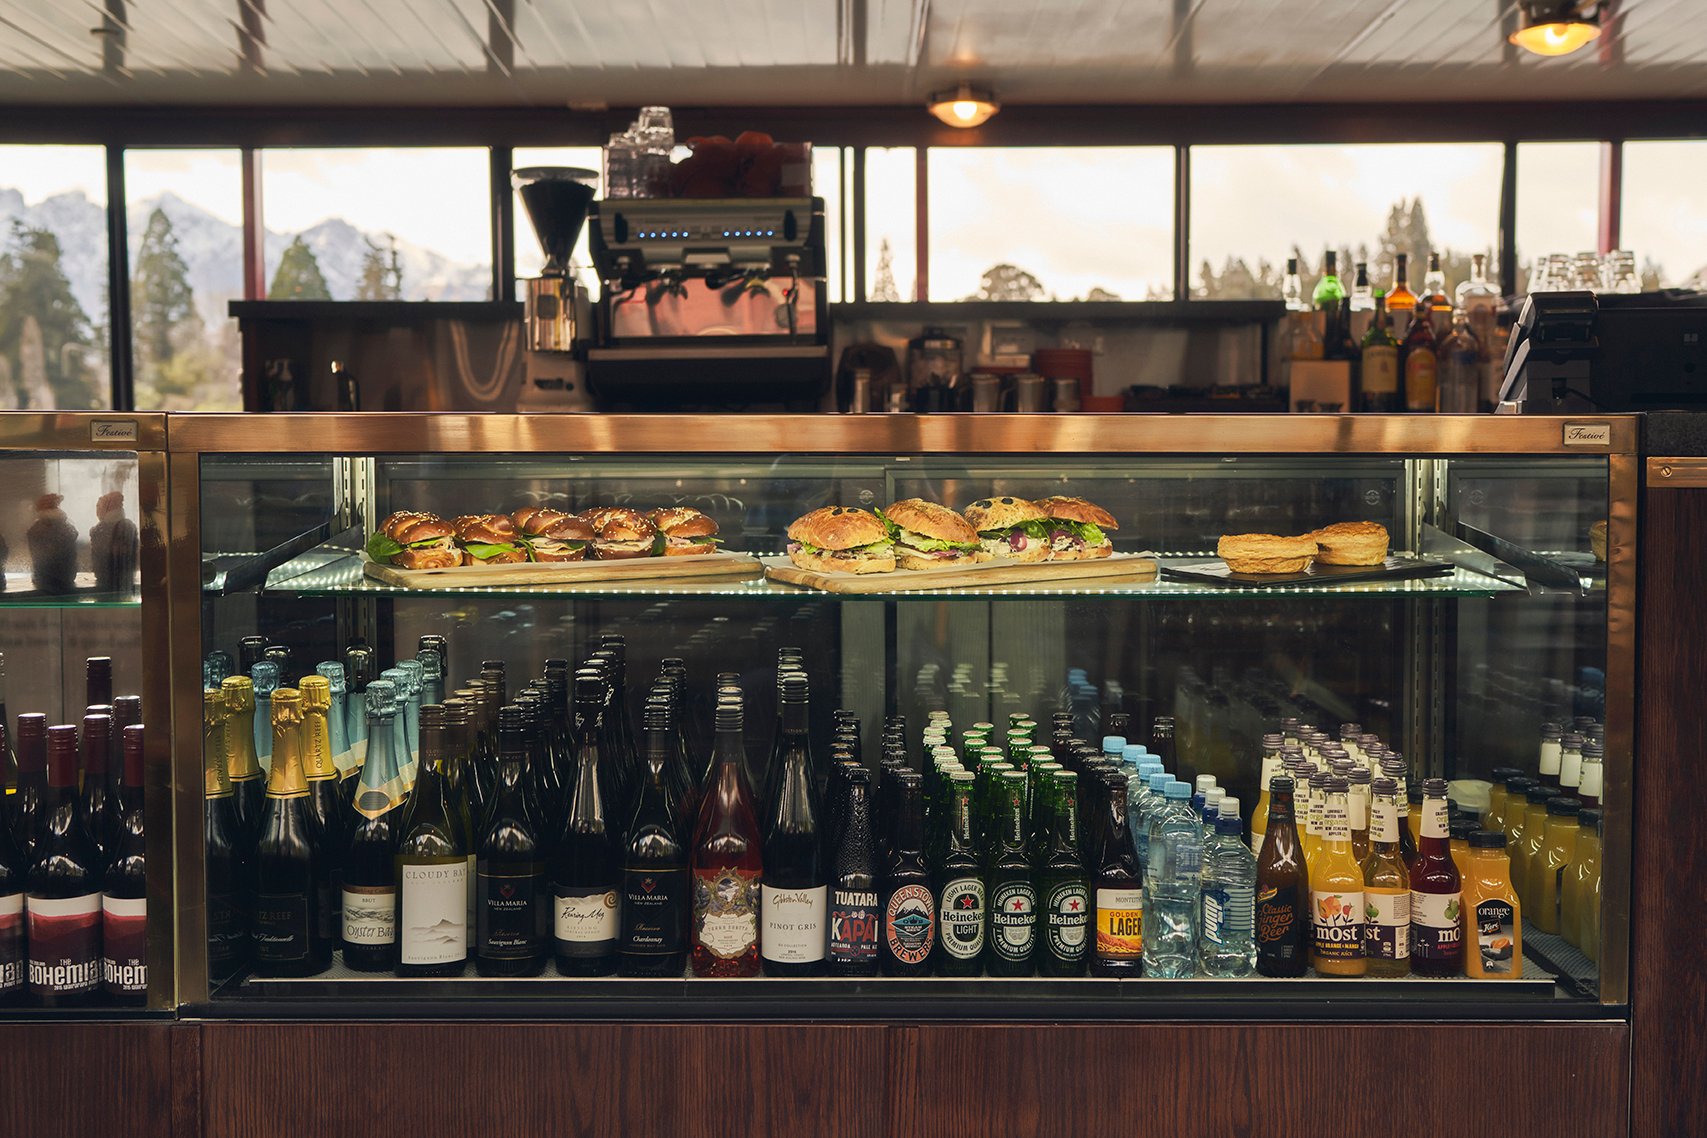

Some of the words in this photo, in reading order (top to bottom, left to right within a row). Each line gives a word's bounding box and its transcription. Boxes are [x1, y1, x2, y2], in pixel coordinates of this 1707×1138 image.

[1568, 427, 1605, 440] Festivé
[315, 739, 323, 769] QUARTZ
[1013, 807, 1021, 841] Heineken
[1068, 807, 1076, 841] Heineken
[405, 870, 449, 880] CLOUDY
[794, 892, 814, 909] Valley
[835, 891, 878, 907] TUATARA
[946, 887, 960, 903] LIGHT
[1262, 903, 1292, 914] Classic
[1478, 907, 1510, 919] orange
[769, 922, 793, 930] PINOT
[1204, 895, 1223, 944] pump
[346, 924, 376, 940] Oyster
[831, 917, 879, 942] KAPAI
[956, 924, 979, 935] LIGHT
[1259, 924, 1289, 943] Beer
[1316, 926, 1358, 942] most
[1366, 926, 1381, 941] st
[1437, 927, 1460, 942] mo
[632, 936, 663, 944] Chardonnay
[945, 932, 969, 951] PREMIUM
[996, 934, 1019, 953] PREMIUM
[890, 938, 932, 961] BREWERS
